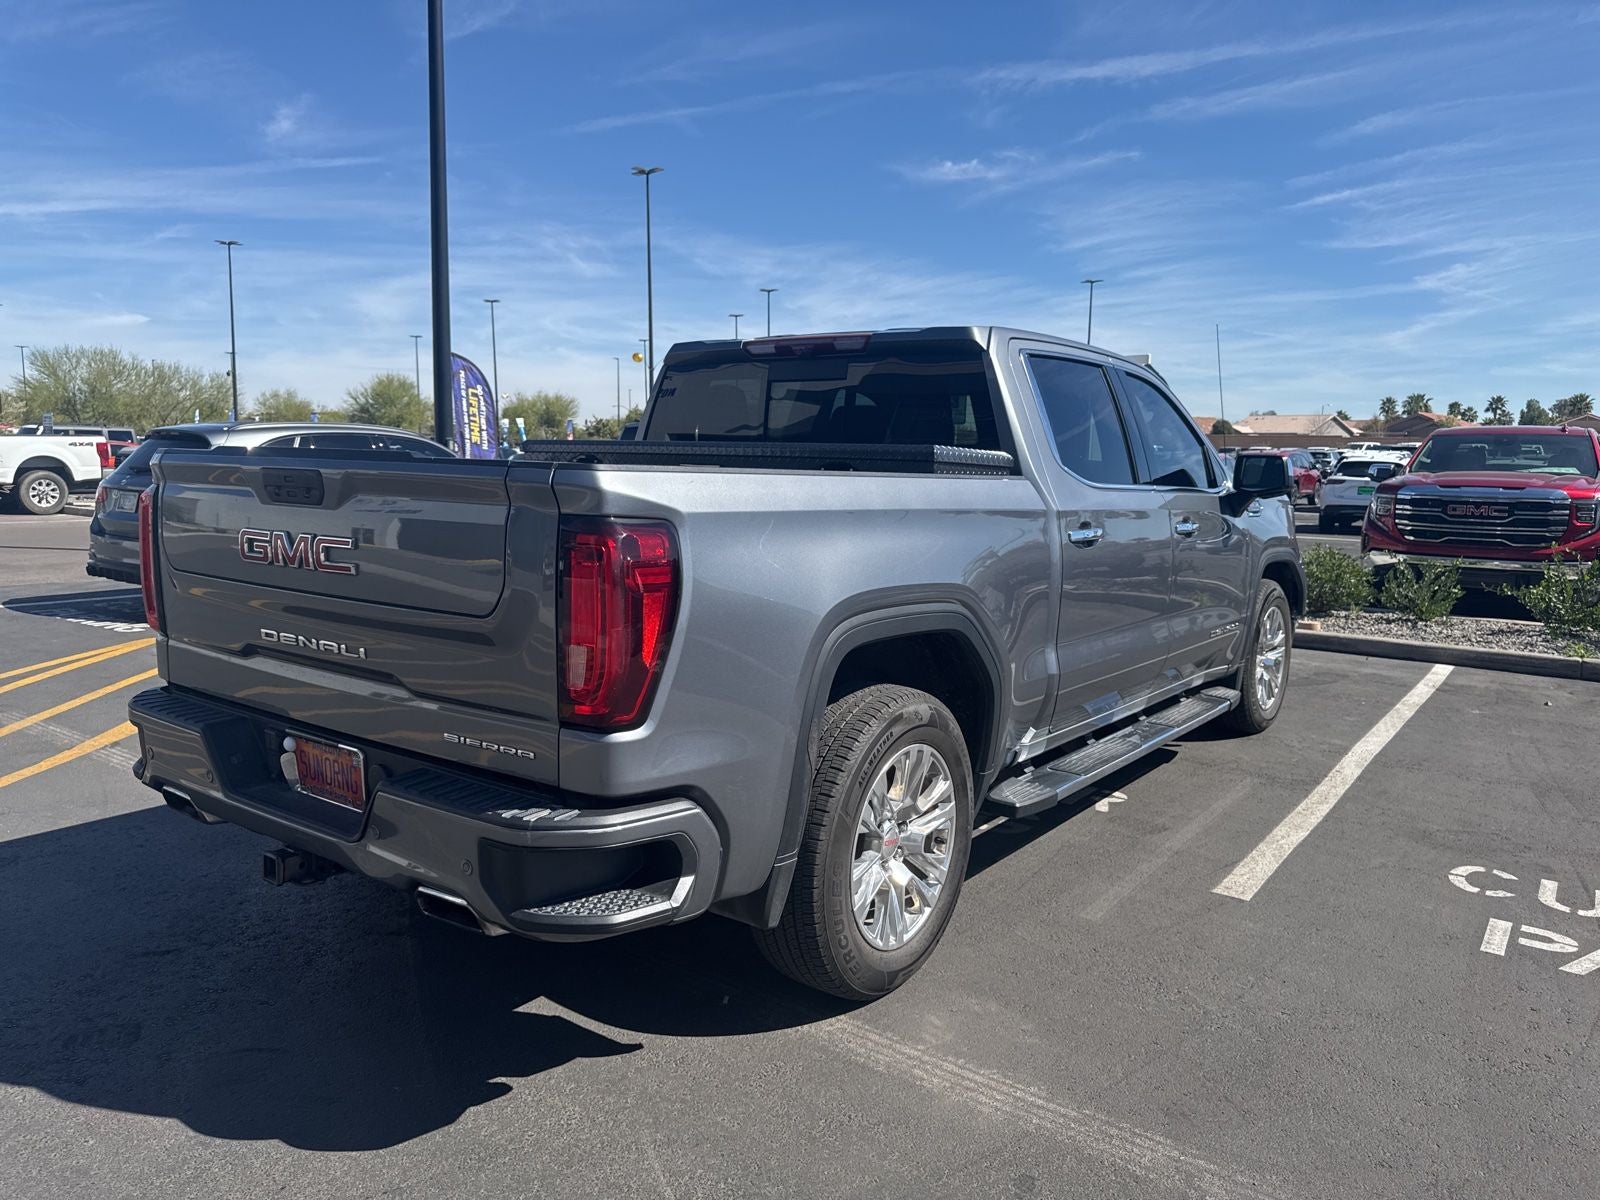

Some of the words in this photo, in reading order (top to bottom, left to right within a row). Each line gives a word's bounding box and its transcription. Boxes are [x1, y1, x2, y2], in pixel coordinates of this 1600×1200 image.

[468, 388, 481, 445] LIFETIME
[481, 430, 489, 450] WITH
[1447, 504, 1509, 517] GMC
[238, 527, 359, 576] GMC
[259, 628, 368, 660] DENALI
[443, 732, 536, 760] SIERRA
[858, 730, 894, 789] ALL-WEATHER
